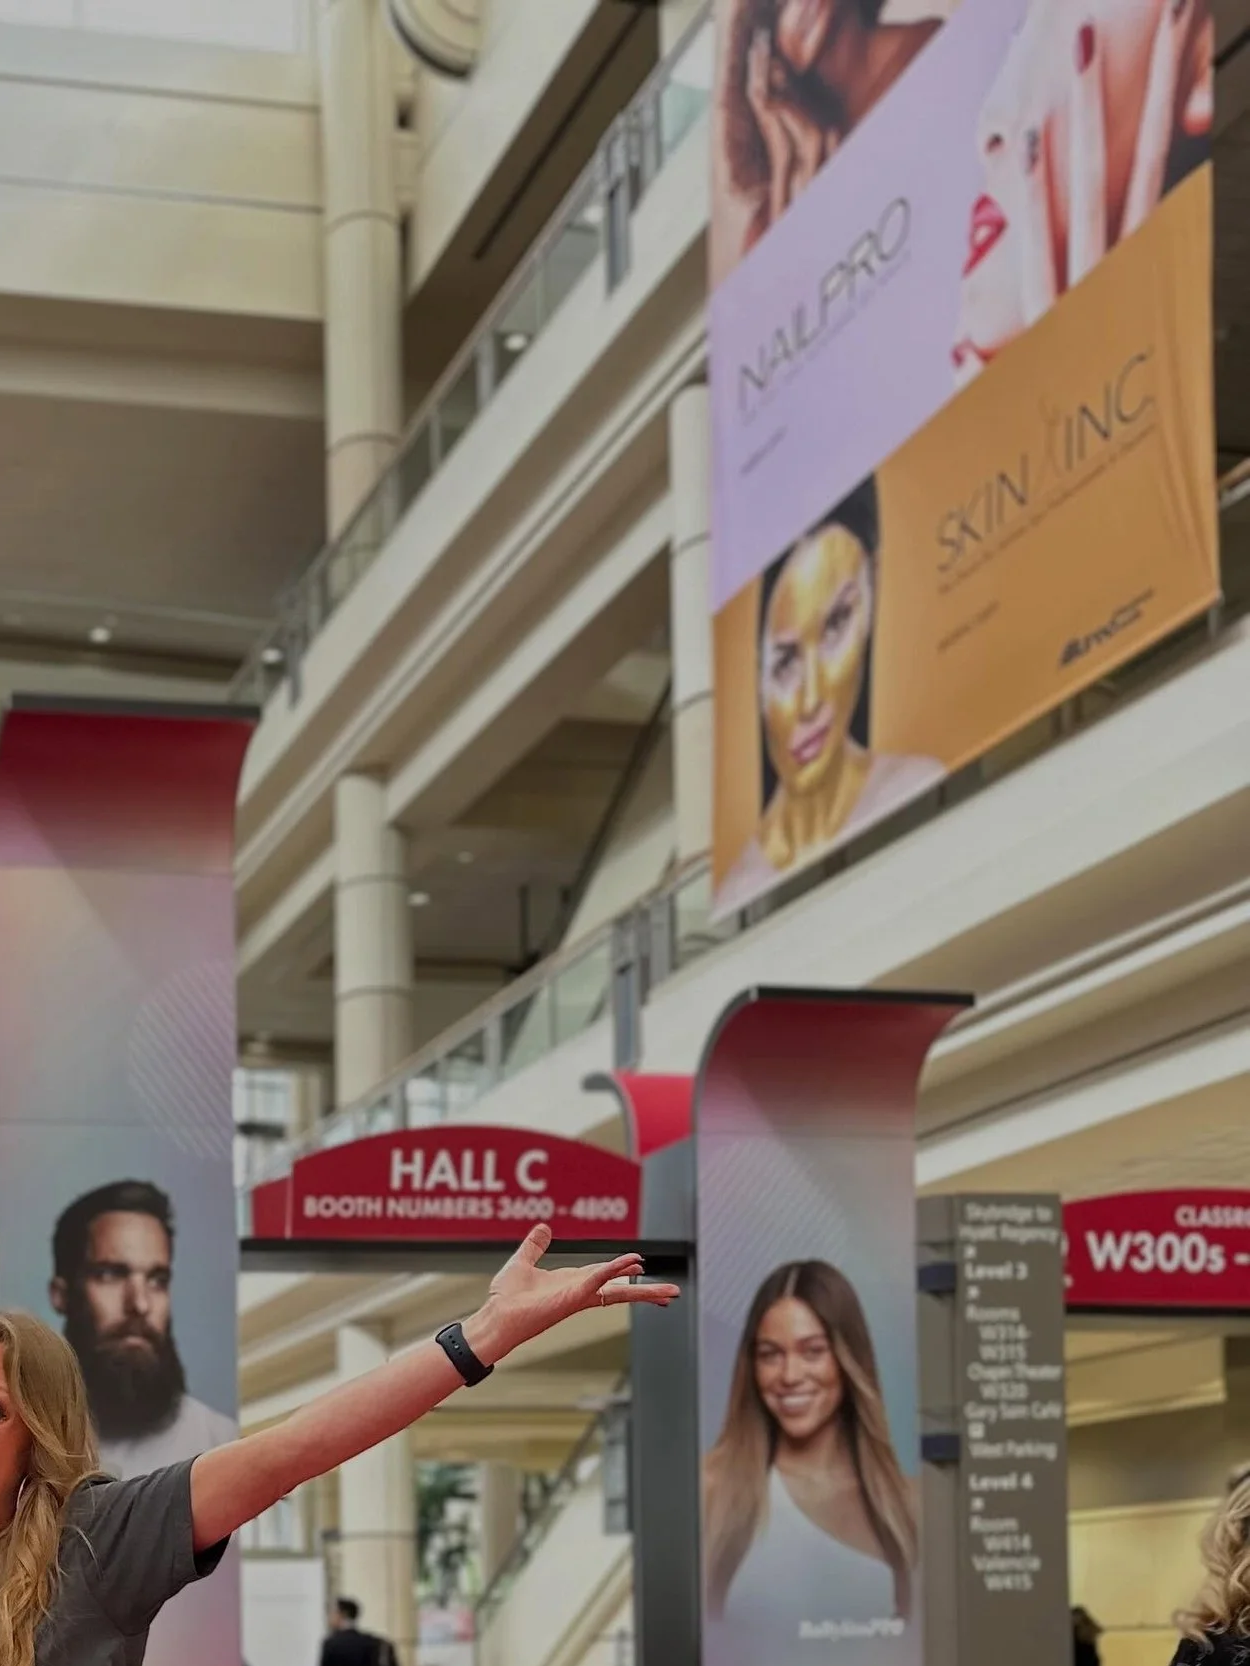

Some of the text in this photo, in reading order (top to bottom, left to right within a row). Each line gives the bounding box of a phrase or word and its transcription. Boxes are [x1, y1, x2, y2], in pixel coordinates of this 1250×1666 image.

[738, 197, 912, 412] NAILPRO
[936, 452, 1029, 574] SKIN
[1064, 347, 1155, 472] INC
[390, 1149, 548, 1192] HALL C
[303, 1196, 380, 1220] BOOTH
[386, 1196, 492, 1220] NUMBERS
[497, 1196, 551, 1221] 3600
[1085, 1231, 1227, 1274] W300s
[964, 1260, 1028, 1280] Level 3
[965, 1304, 1020, 1322] Rooms
[968, 1471, 1018, 1491] Level
